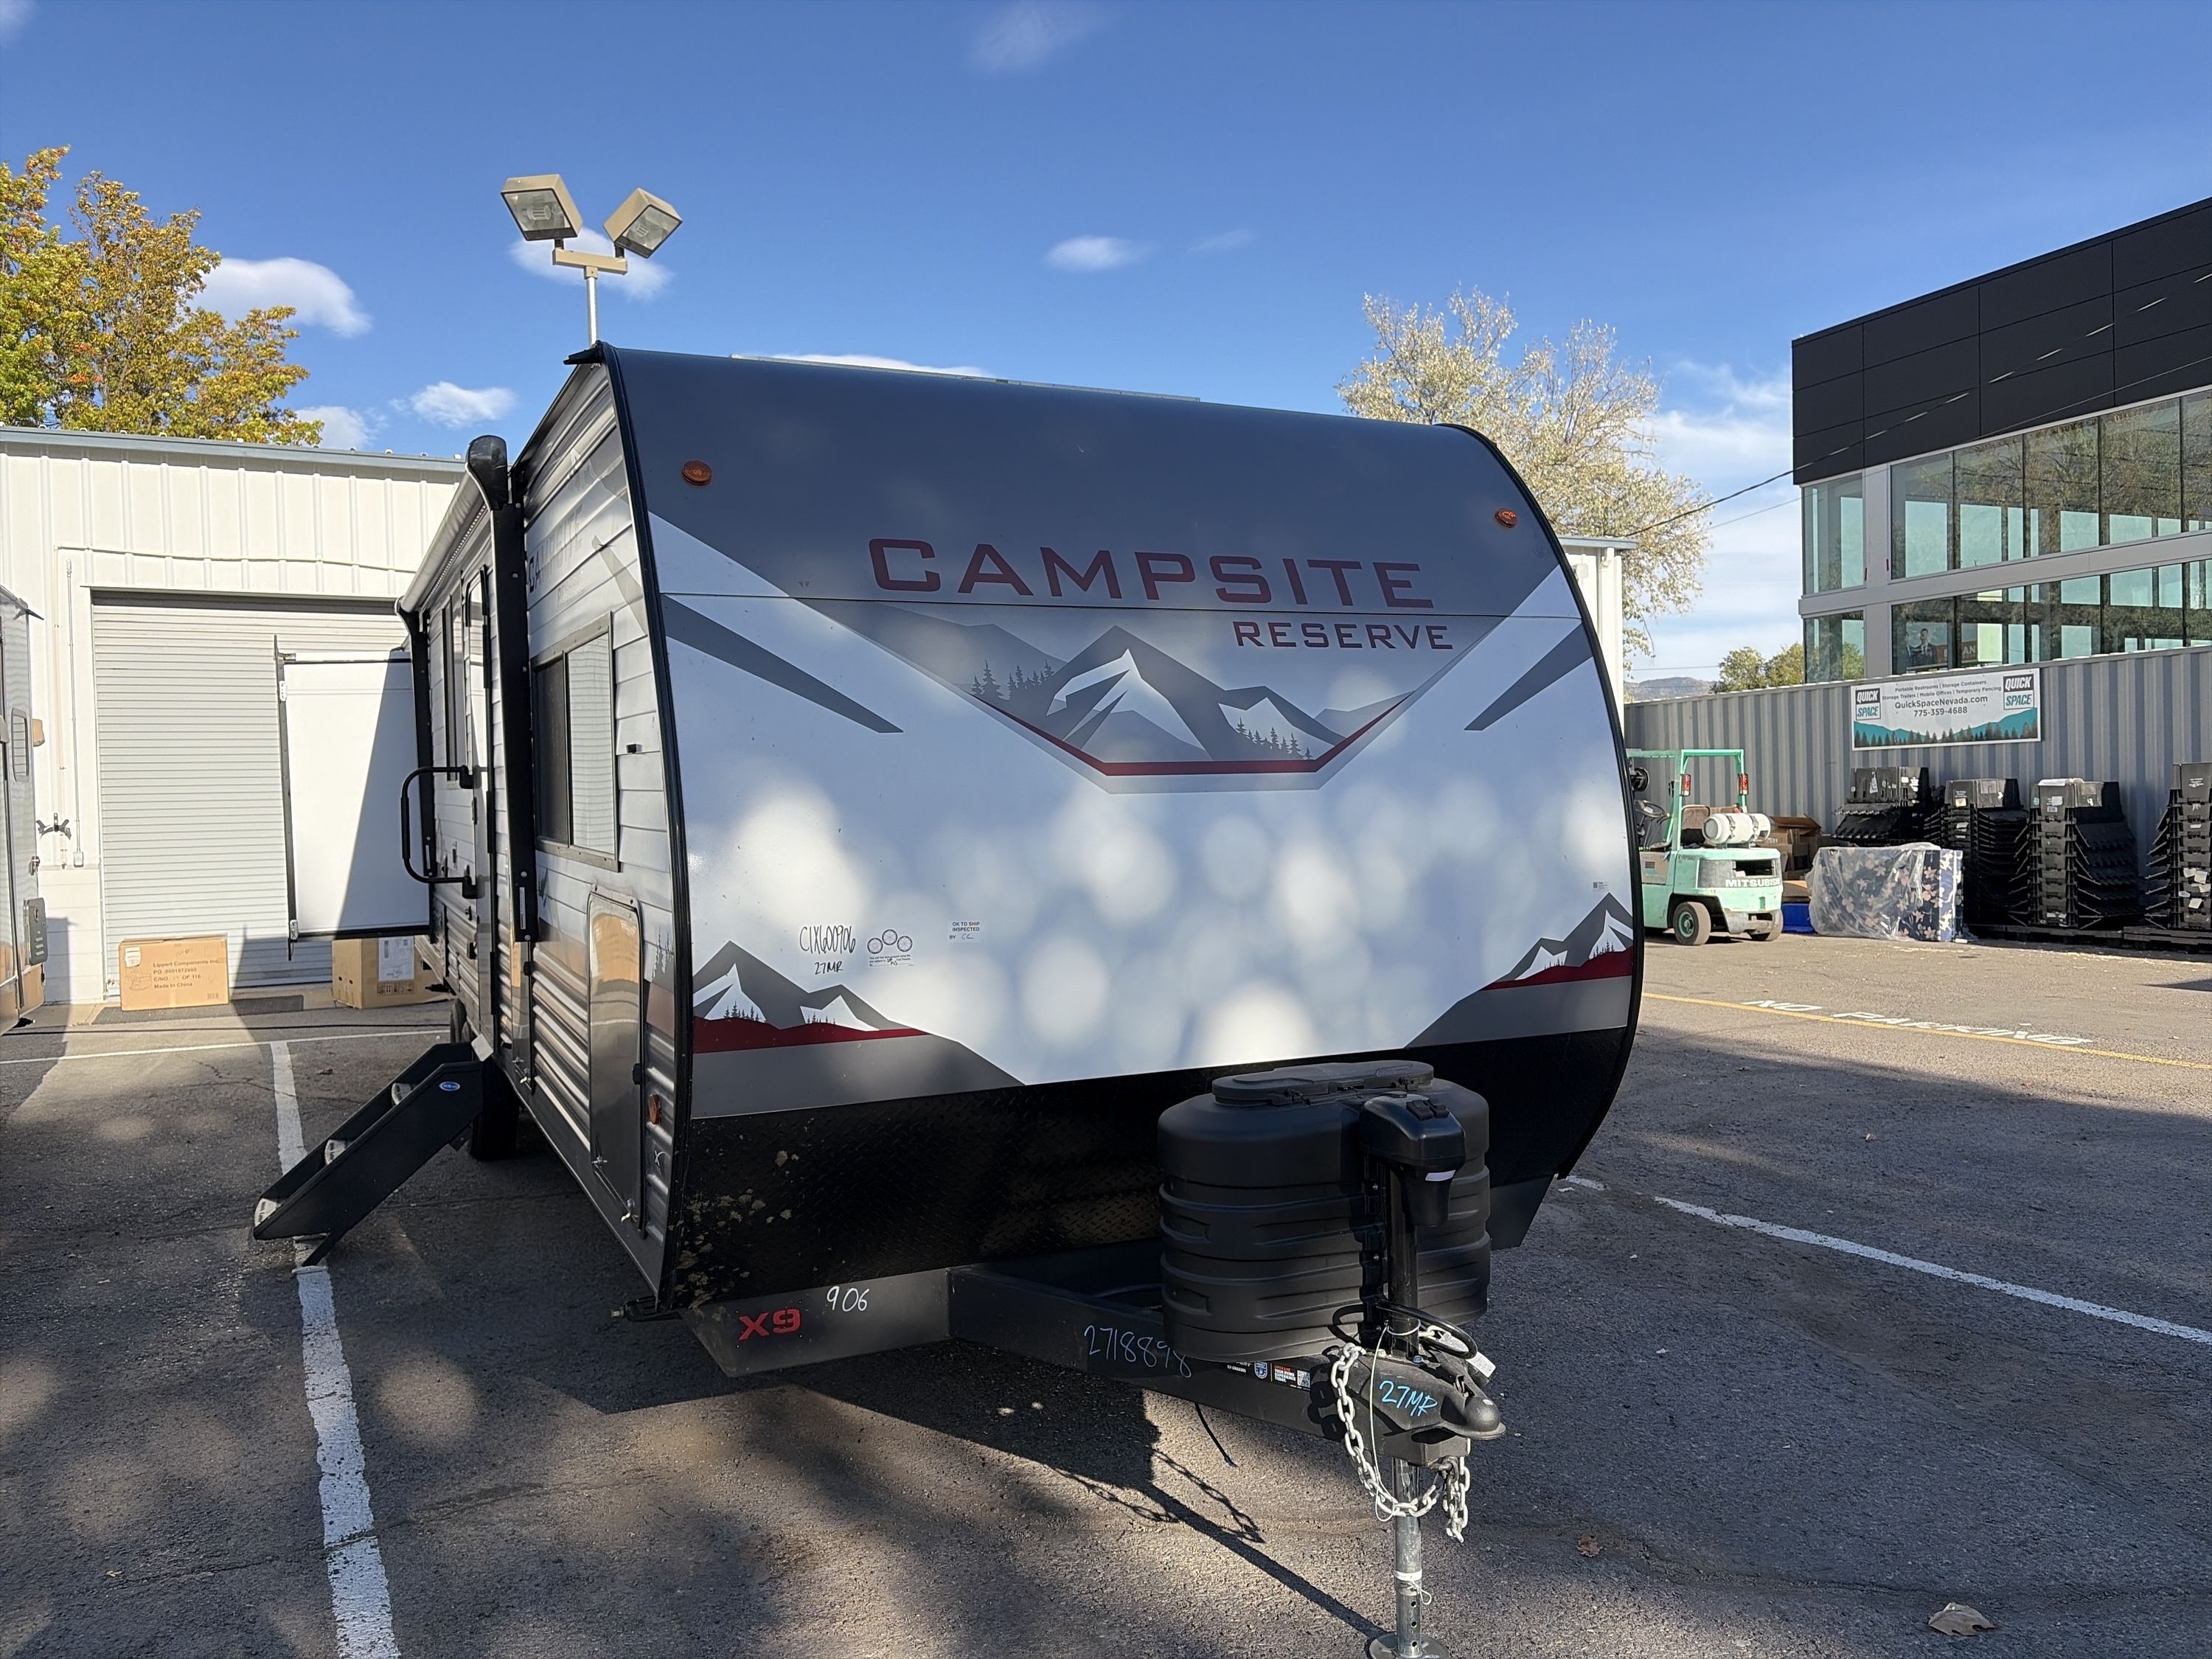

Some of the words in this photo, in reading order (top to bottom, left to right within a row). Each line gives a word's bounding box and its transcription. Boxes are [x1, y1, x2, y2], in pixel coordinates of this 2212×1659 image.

[868, 538, 1435, 609] CAMPSITE
[1232, 620, 1454, 650] RESERVE
[1894, 685, 1913, 693] Portable
[1941, 682, 1961, 690] Storage
[2004, 676, 2033, 690] QUICK
[1856, 690, 1879, 703] QUICK
[1955, 686, 1981, 695] Temporary
[1982, 685, 2002, 693] Fencing
[1894, 696, 1989, 709] QuickSpaceNevada.com
[2005, 693, 2033, 706] SPACE
[1857, 706, 1879, 717] SPACE
[1913, 706, 1968, 717] 775-359-4688
[814, 961, 844, 975] 27MR
[826, 1286, 870, 1312] 906
[738, 1308, 801, 1341] X9
[1379, 1380, 1438, 1417] 27MR
